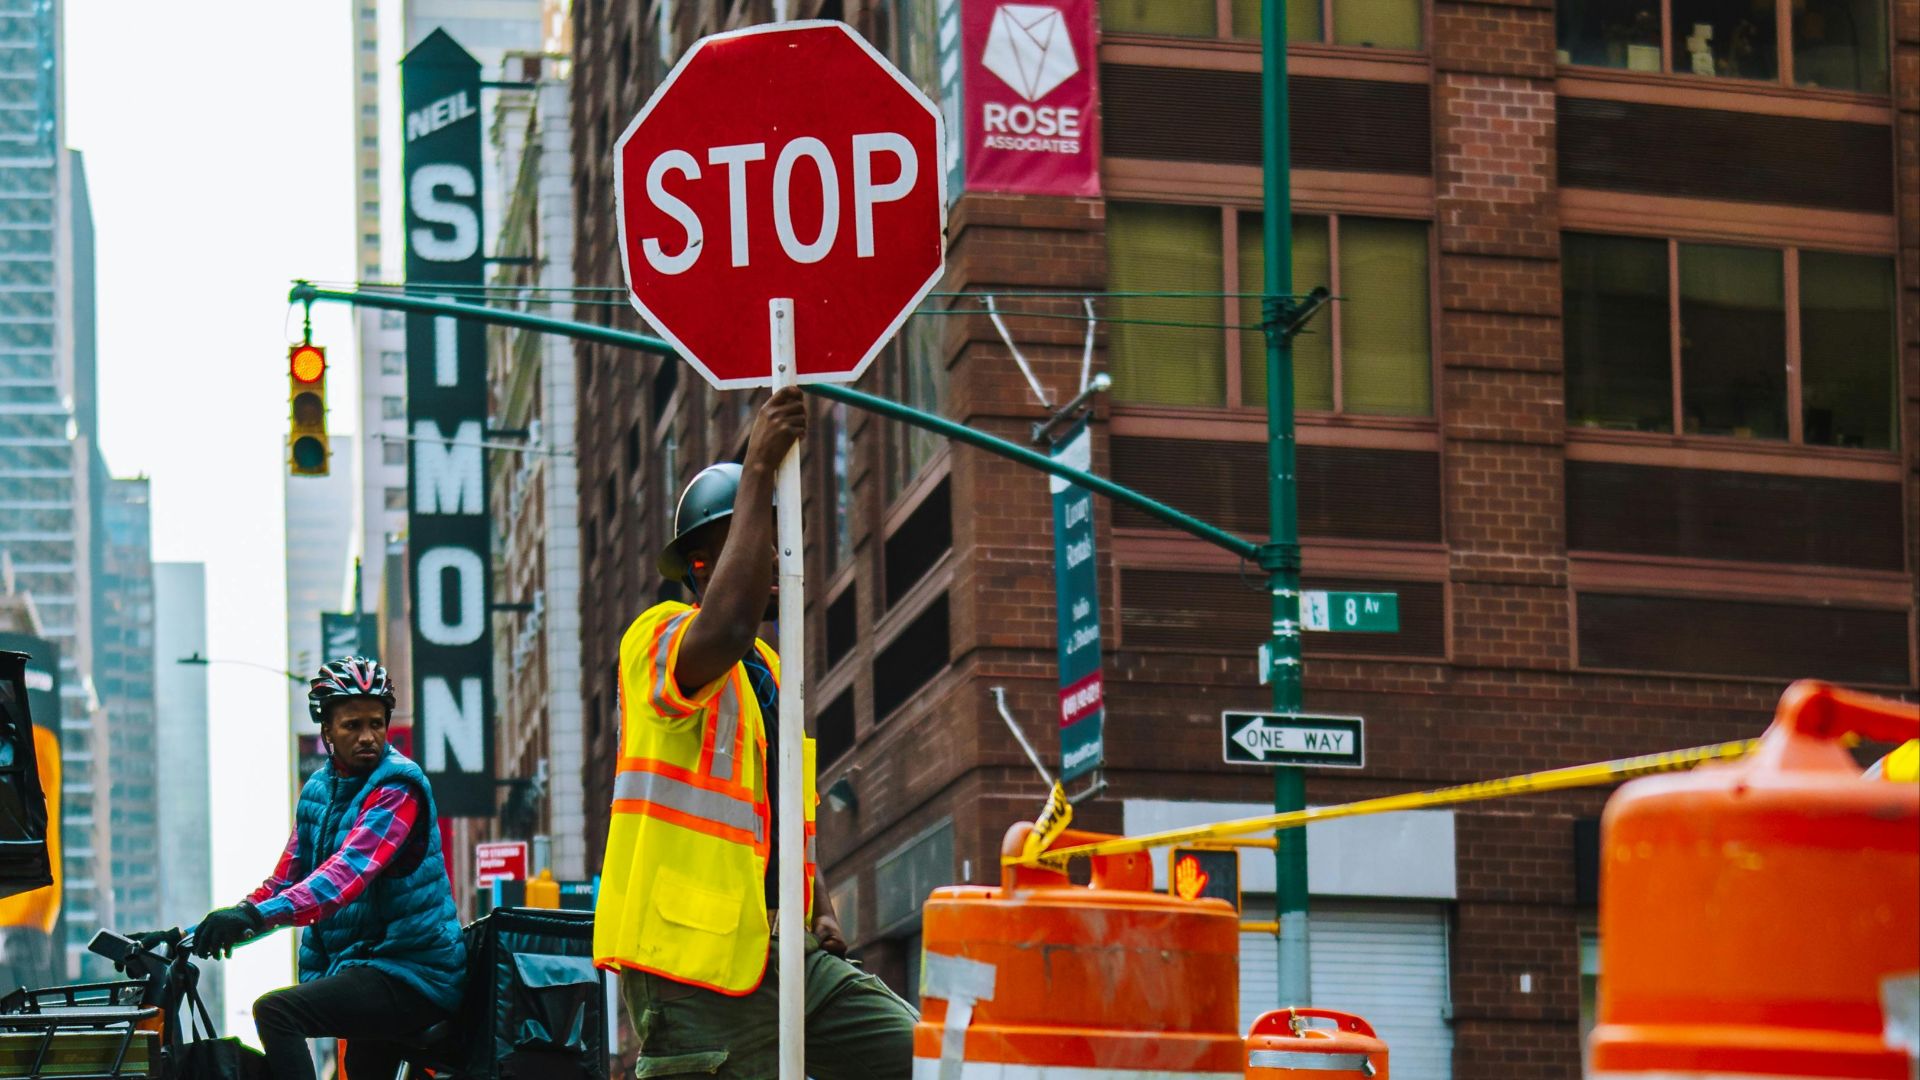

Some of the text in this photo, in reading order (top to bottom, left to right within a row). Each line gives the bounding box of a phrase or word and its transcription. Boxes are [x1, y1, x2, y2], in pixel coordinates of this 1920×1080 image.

[407, 90, 476, 143] NEIL
[983, 103, 1080, 138] ROSE
[984, 135, 1080, 154] ASSOCIATES
[641, 131, 919, 276] STOP
[410, 163, 485, 774] SIMON
[1345, 597, 1380, 626] 8 Av
[1246, 729, 1344, 751] ONE WAY
